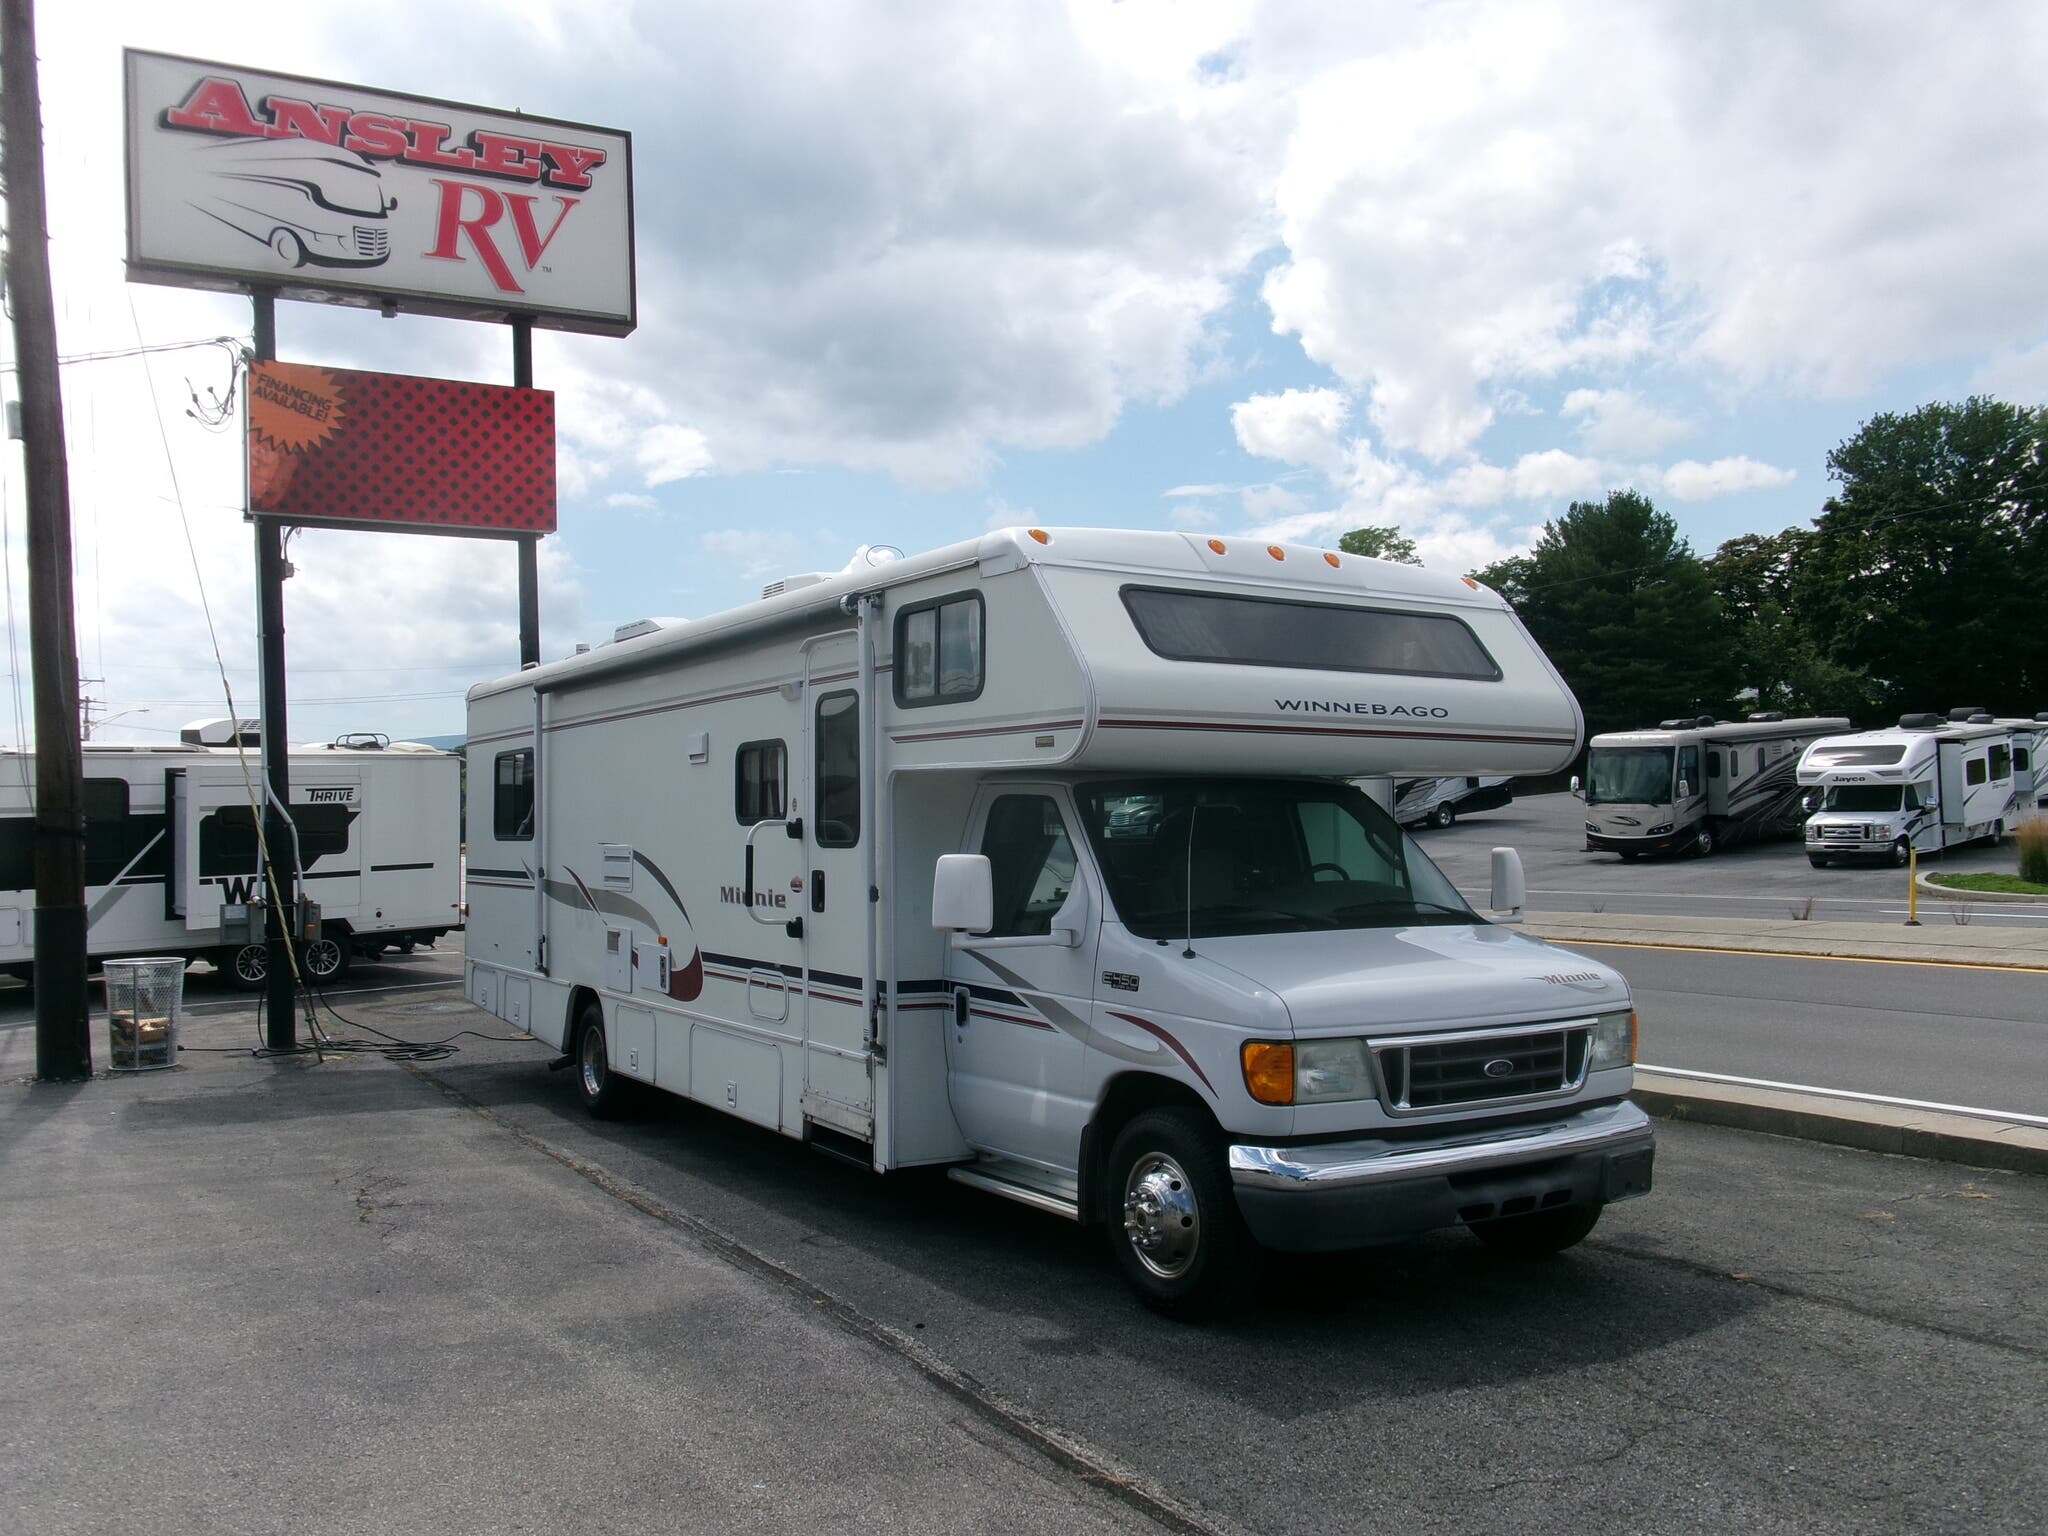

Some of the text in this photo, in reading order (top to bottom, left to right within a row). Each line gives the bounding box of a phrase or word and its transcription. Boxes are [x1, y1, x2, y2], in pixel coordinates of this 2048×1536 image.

[160, 76, 607, 191] ANSLEY
[423, 178, 581, 294] RV
[254, 385, 328, 422] AVAILABLE!
[258, 373, 333, 411] FINANCING
[1274, 699, 1449, 719] WINNEBAGO
[1832, 775, 1866, 783] Jayco
[305, 787, 354, 802] THRIVE
[1544, 971, 1601, 985] Minnie
